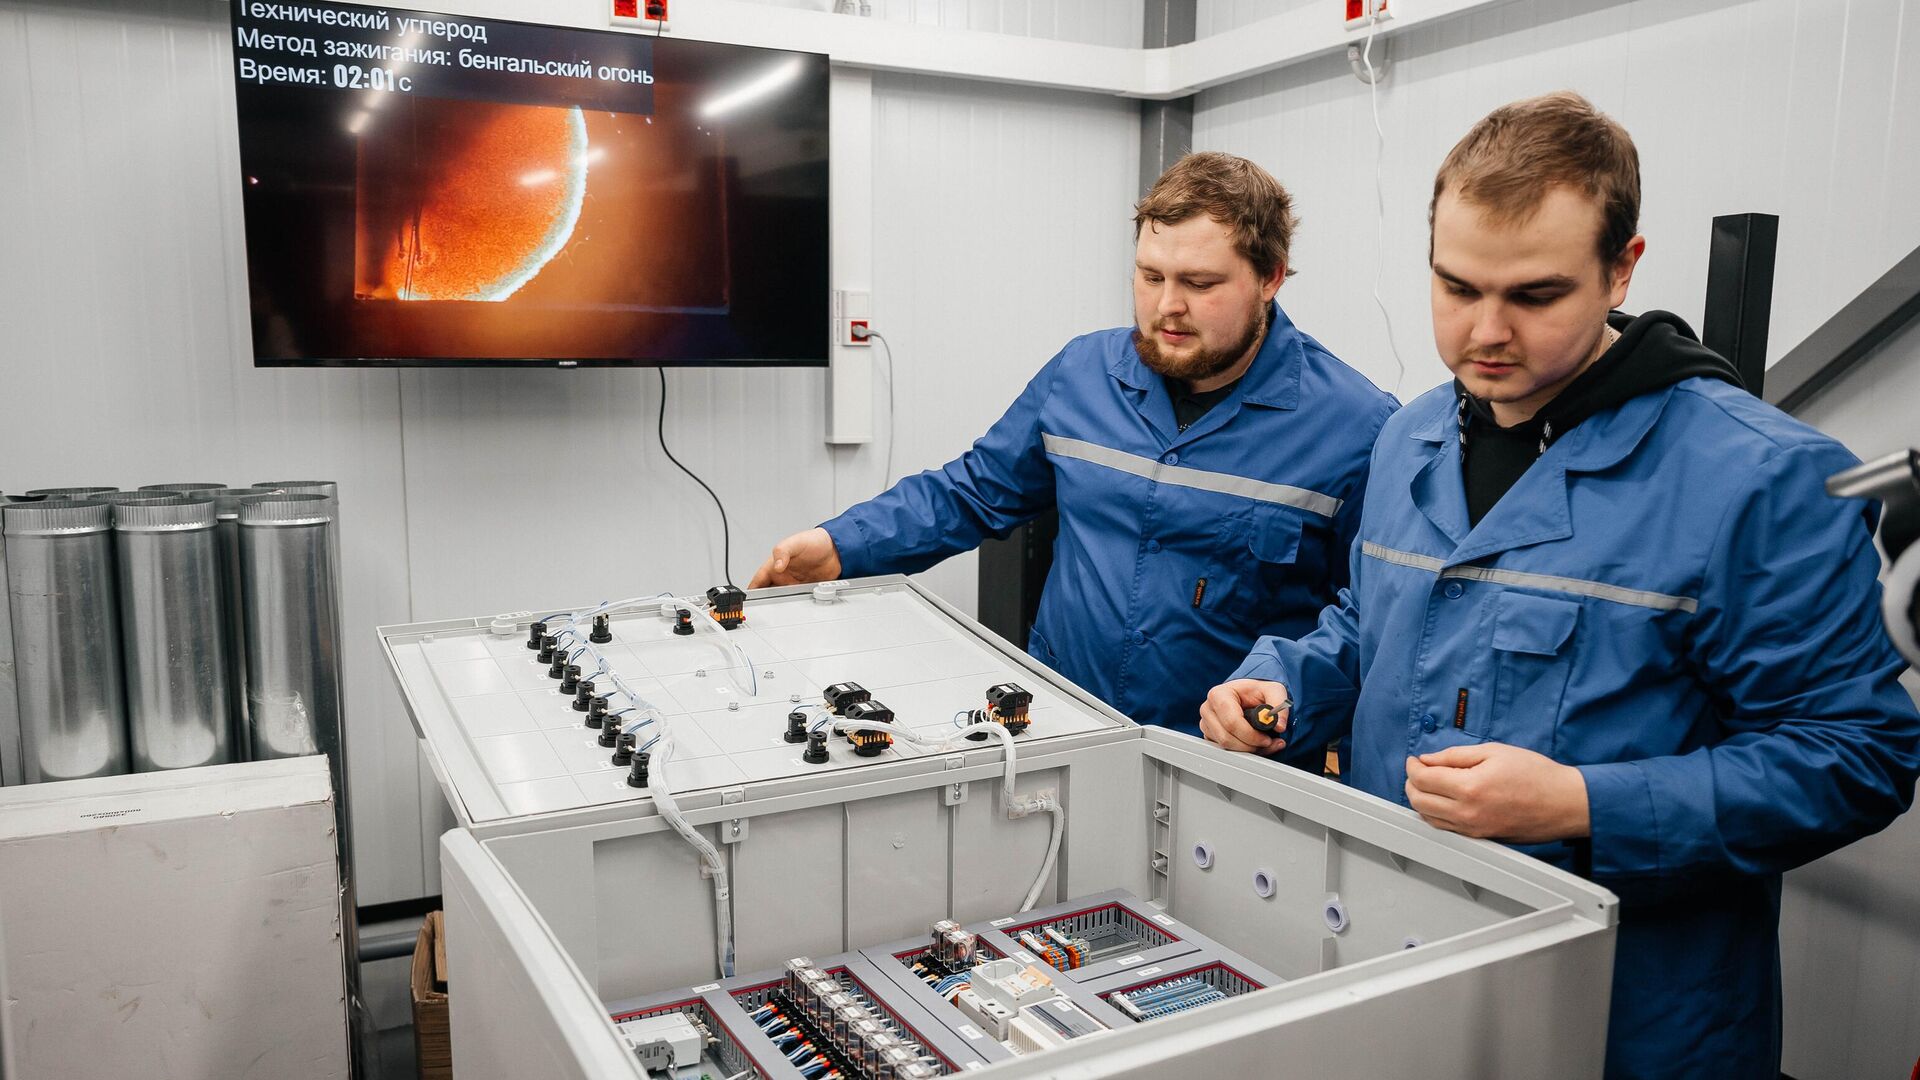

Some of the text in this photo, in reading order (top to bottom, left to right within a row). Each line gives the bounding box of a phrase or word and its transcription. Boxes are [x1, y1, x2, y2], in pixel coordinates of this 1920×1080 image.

[240, 0, 488, 44] Технический углерод
[237, 26, 655, 85] Метод зажигания: бенгальский огонь
[239, 57, 327, 85] Время:
[333, 63, 395, 92] 02:01
